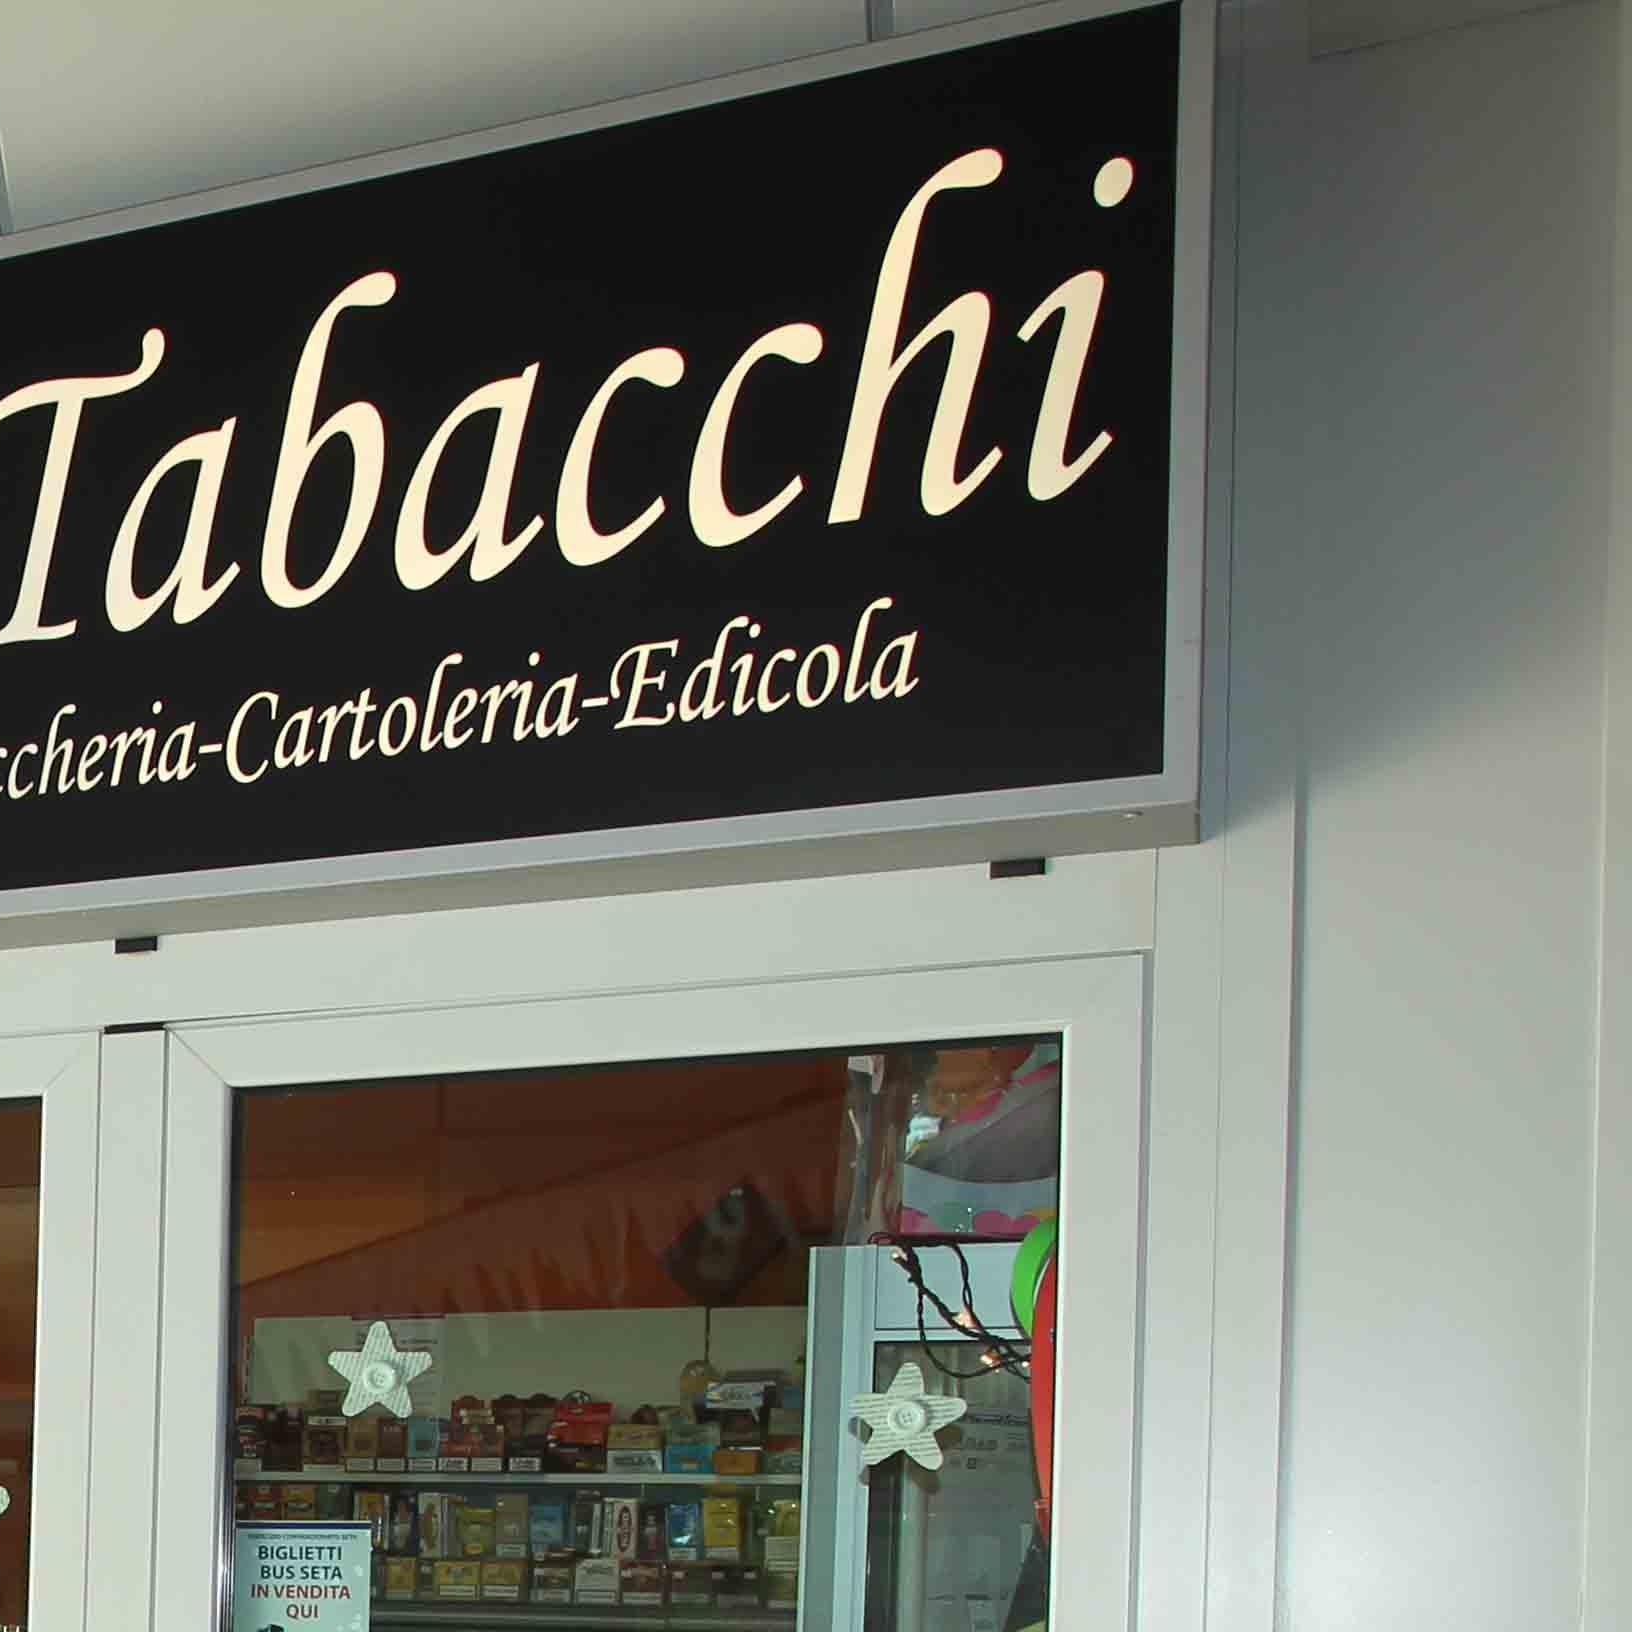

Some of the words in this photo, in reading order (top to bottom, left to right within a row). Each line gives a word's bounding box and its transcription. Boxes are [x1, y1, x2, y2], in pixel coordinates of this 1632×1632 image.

[258, 1545, 342, 1560] BIGLIETTI
[261, 1565, 295, 1579] BUS
[300, 1566, 342, 1580] SETA
[251, 1584, 268, 1598] IN
[274, 1585, 350, 1599] VENDITA
[286, 1604, 319, 1619] QUI
